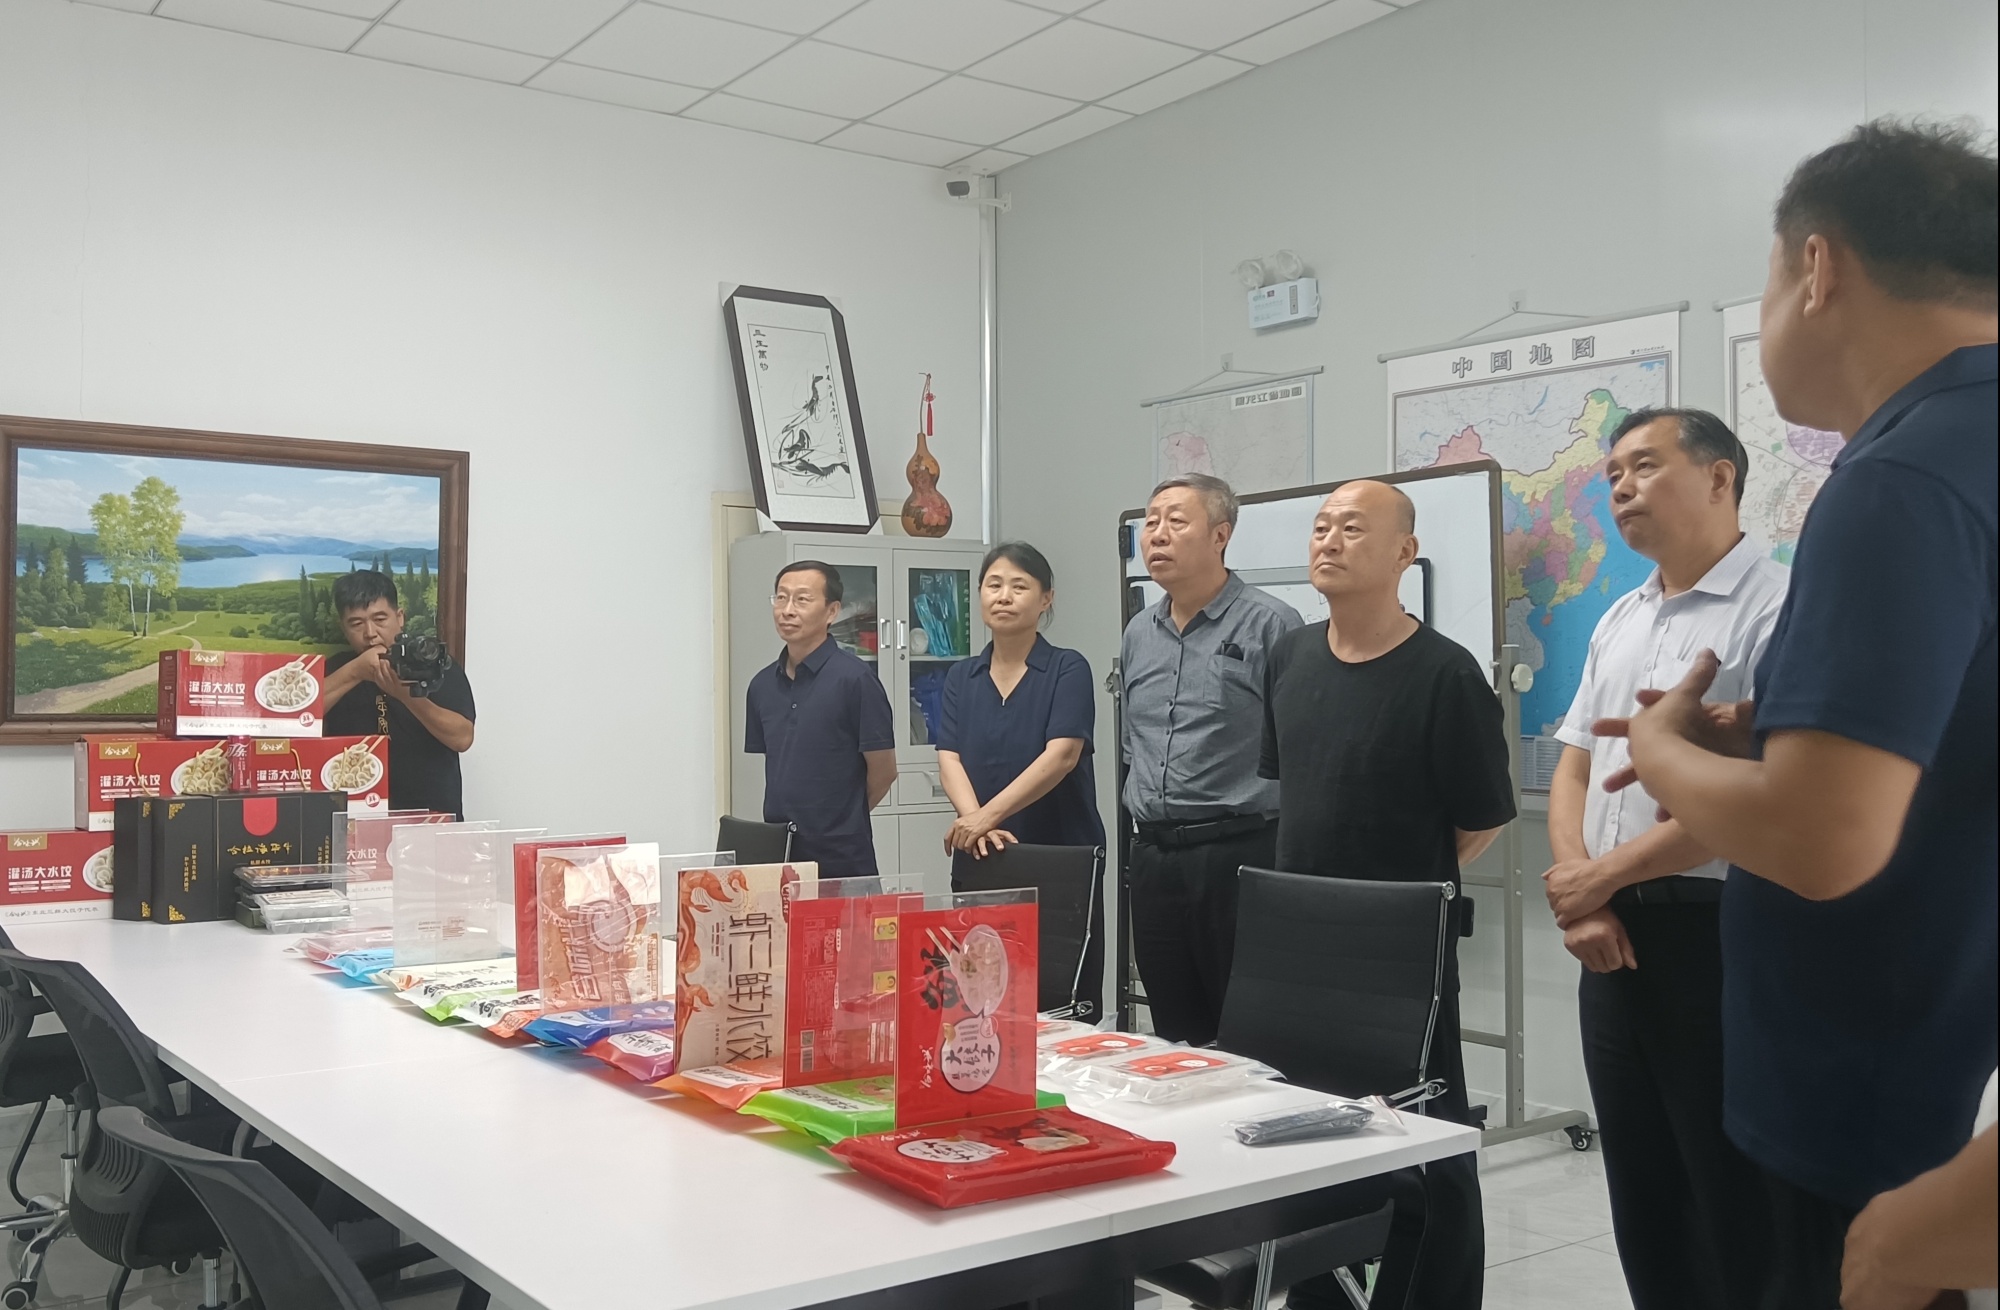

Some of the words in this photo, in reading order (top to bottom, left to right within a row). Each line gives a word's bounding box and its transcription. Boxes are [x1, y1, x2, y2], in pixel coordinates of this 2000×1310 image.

[1452, 336, 1595, 378] 中国地图
[189, 681, 246, 694] 灌汤大水饺
[100, 774, 161, 788] 灌汤大水饺
[257, 769, 312, 781] 灌汤大水饺
[8, 865, 73, 879] 灌汤大水饺
